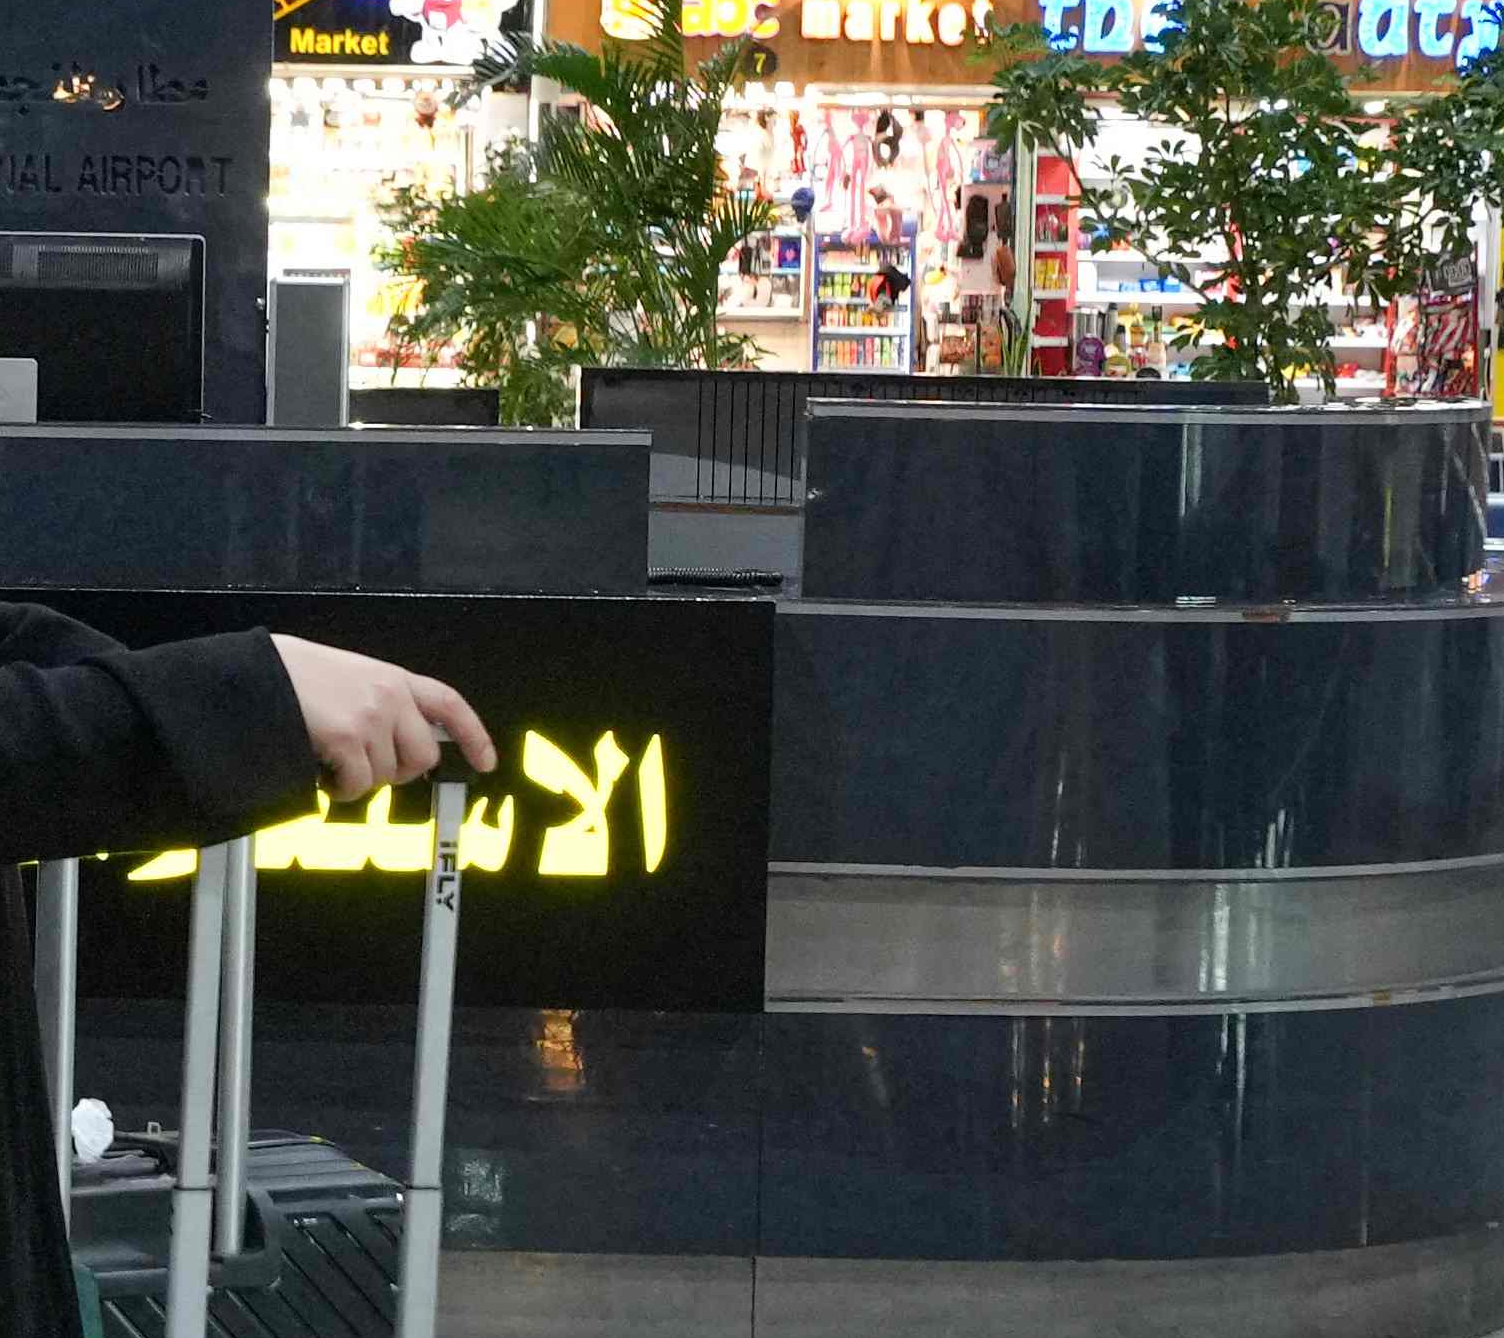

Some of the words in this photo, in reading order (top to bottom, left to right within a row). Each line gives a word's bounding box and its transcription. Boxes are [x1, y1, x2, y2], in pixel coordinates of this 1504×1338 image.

[289, 27, 389, 56] Market
[752, 52, 767, 74] 7
[78, 154, 233, 195] AIRPORT
